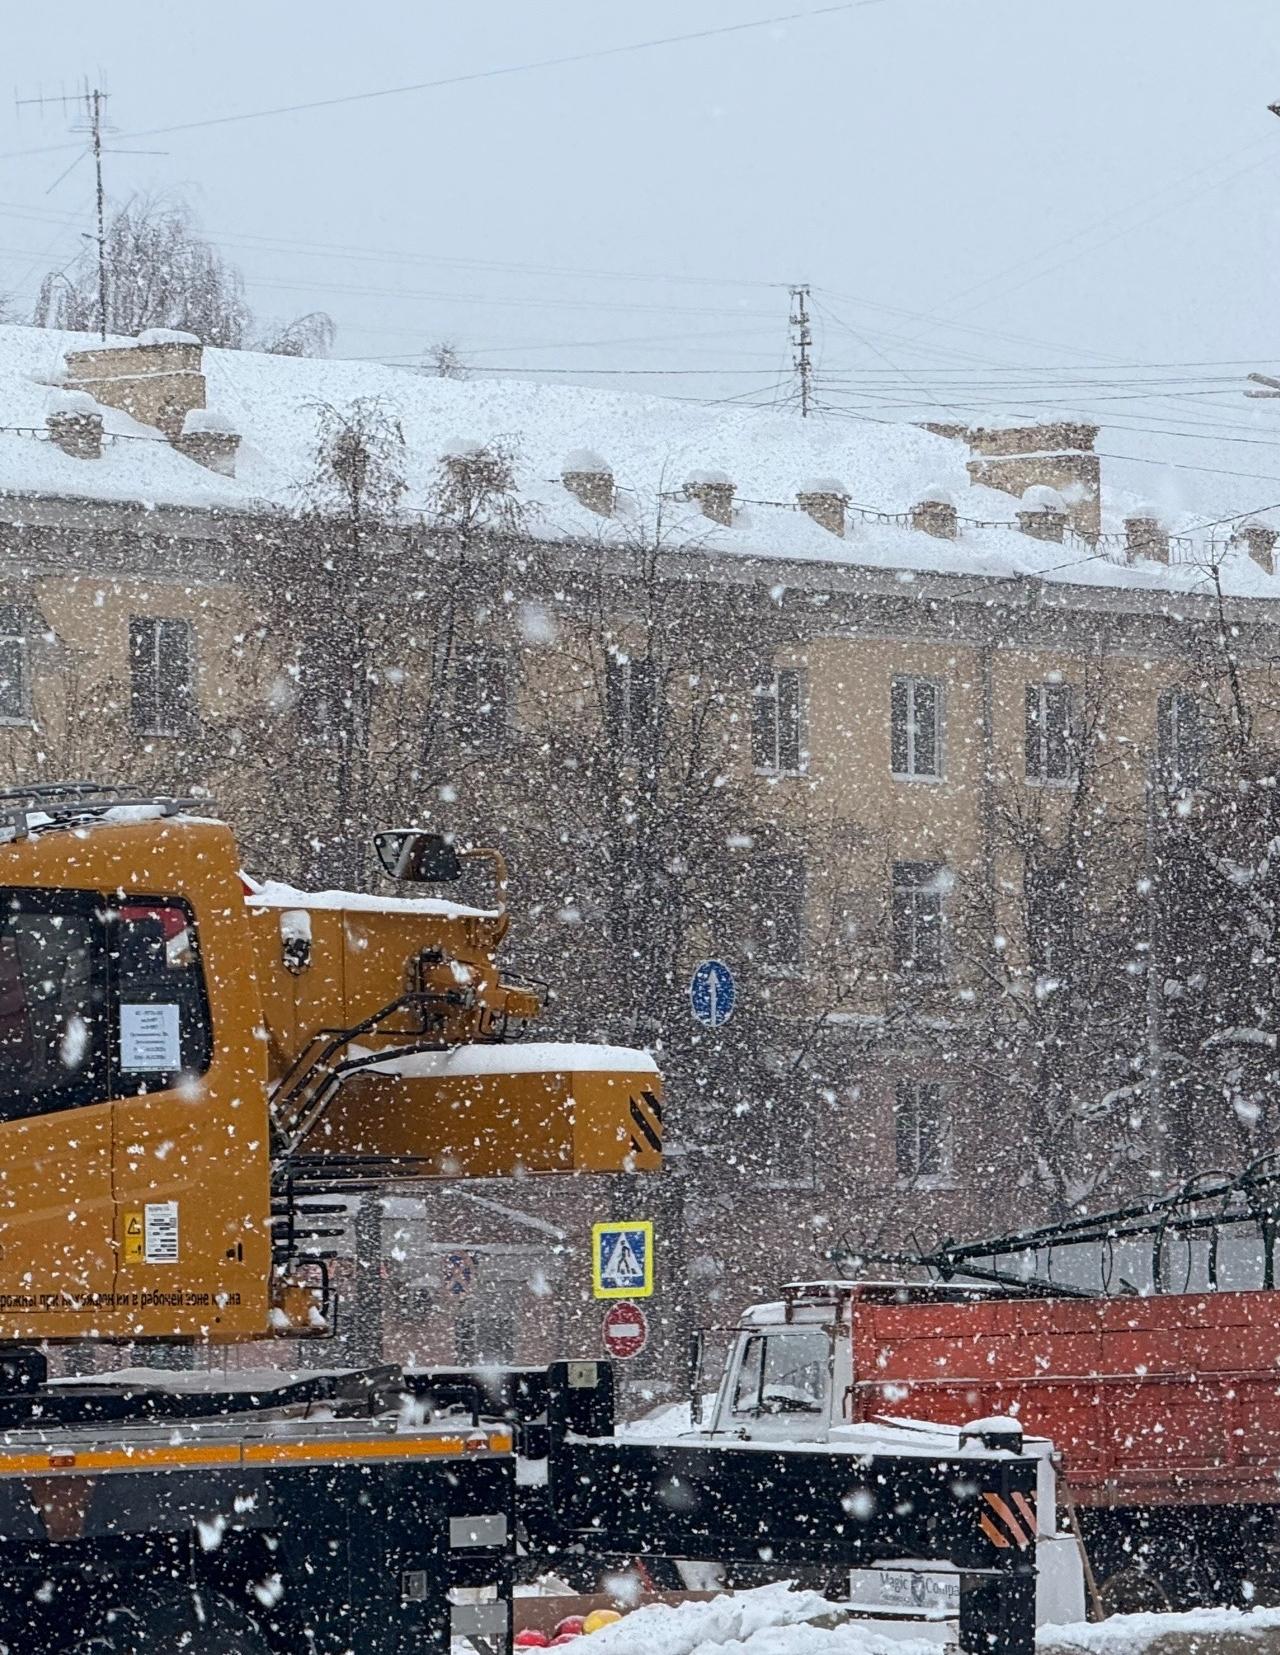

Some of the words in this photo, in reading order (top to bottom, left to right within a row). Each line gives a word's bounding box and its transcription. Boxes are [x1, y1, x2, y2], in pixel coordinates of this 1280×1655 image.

[62, 1293, 129, 1309] нхождении
[141, 1289, 183, 1310] рабочей
[185, 1293, 209, 1306] зоне
[211, 1293, 241, 1306] кна
